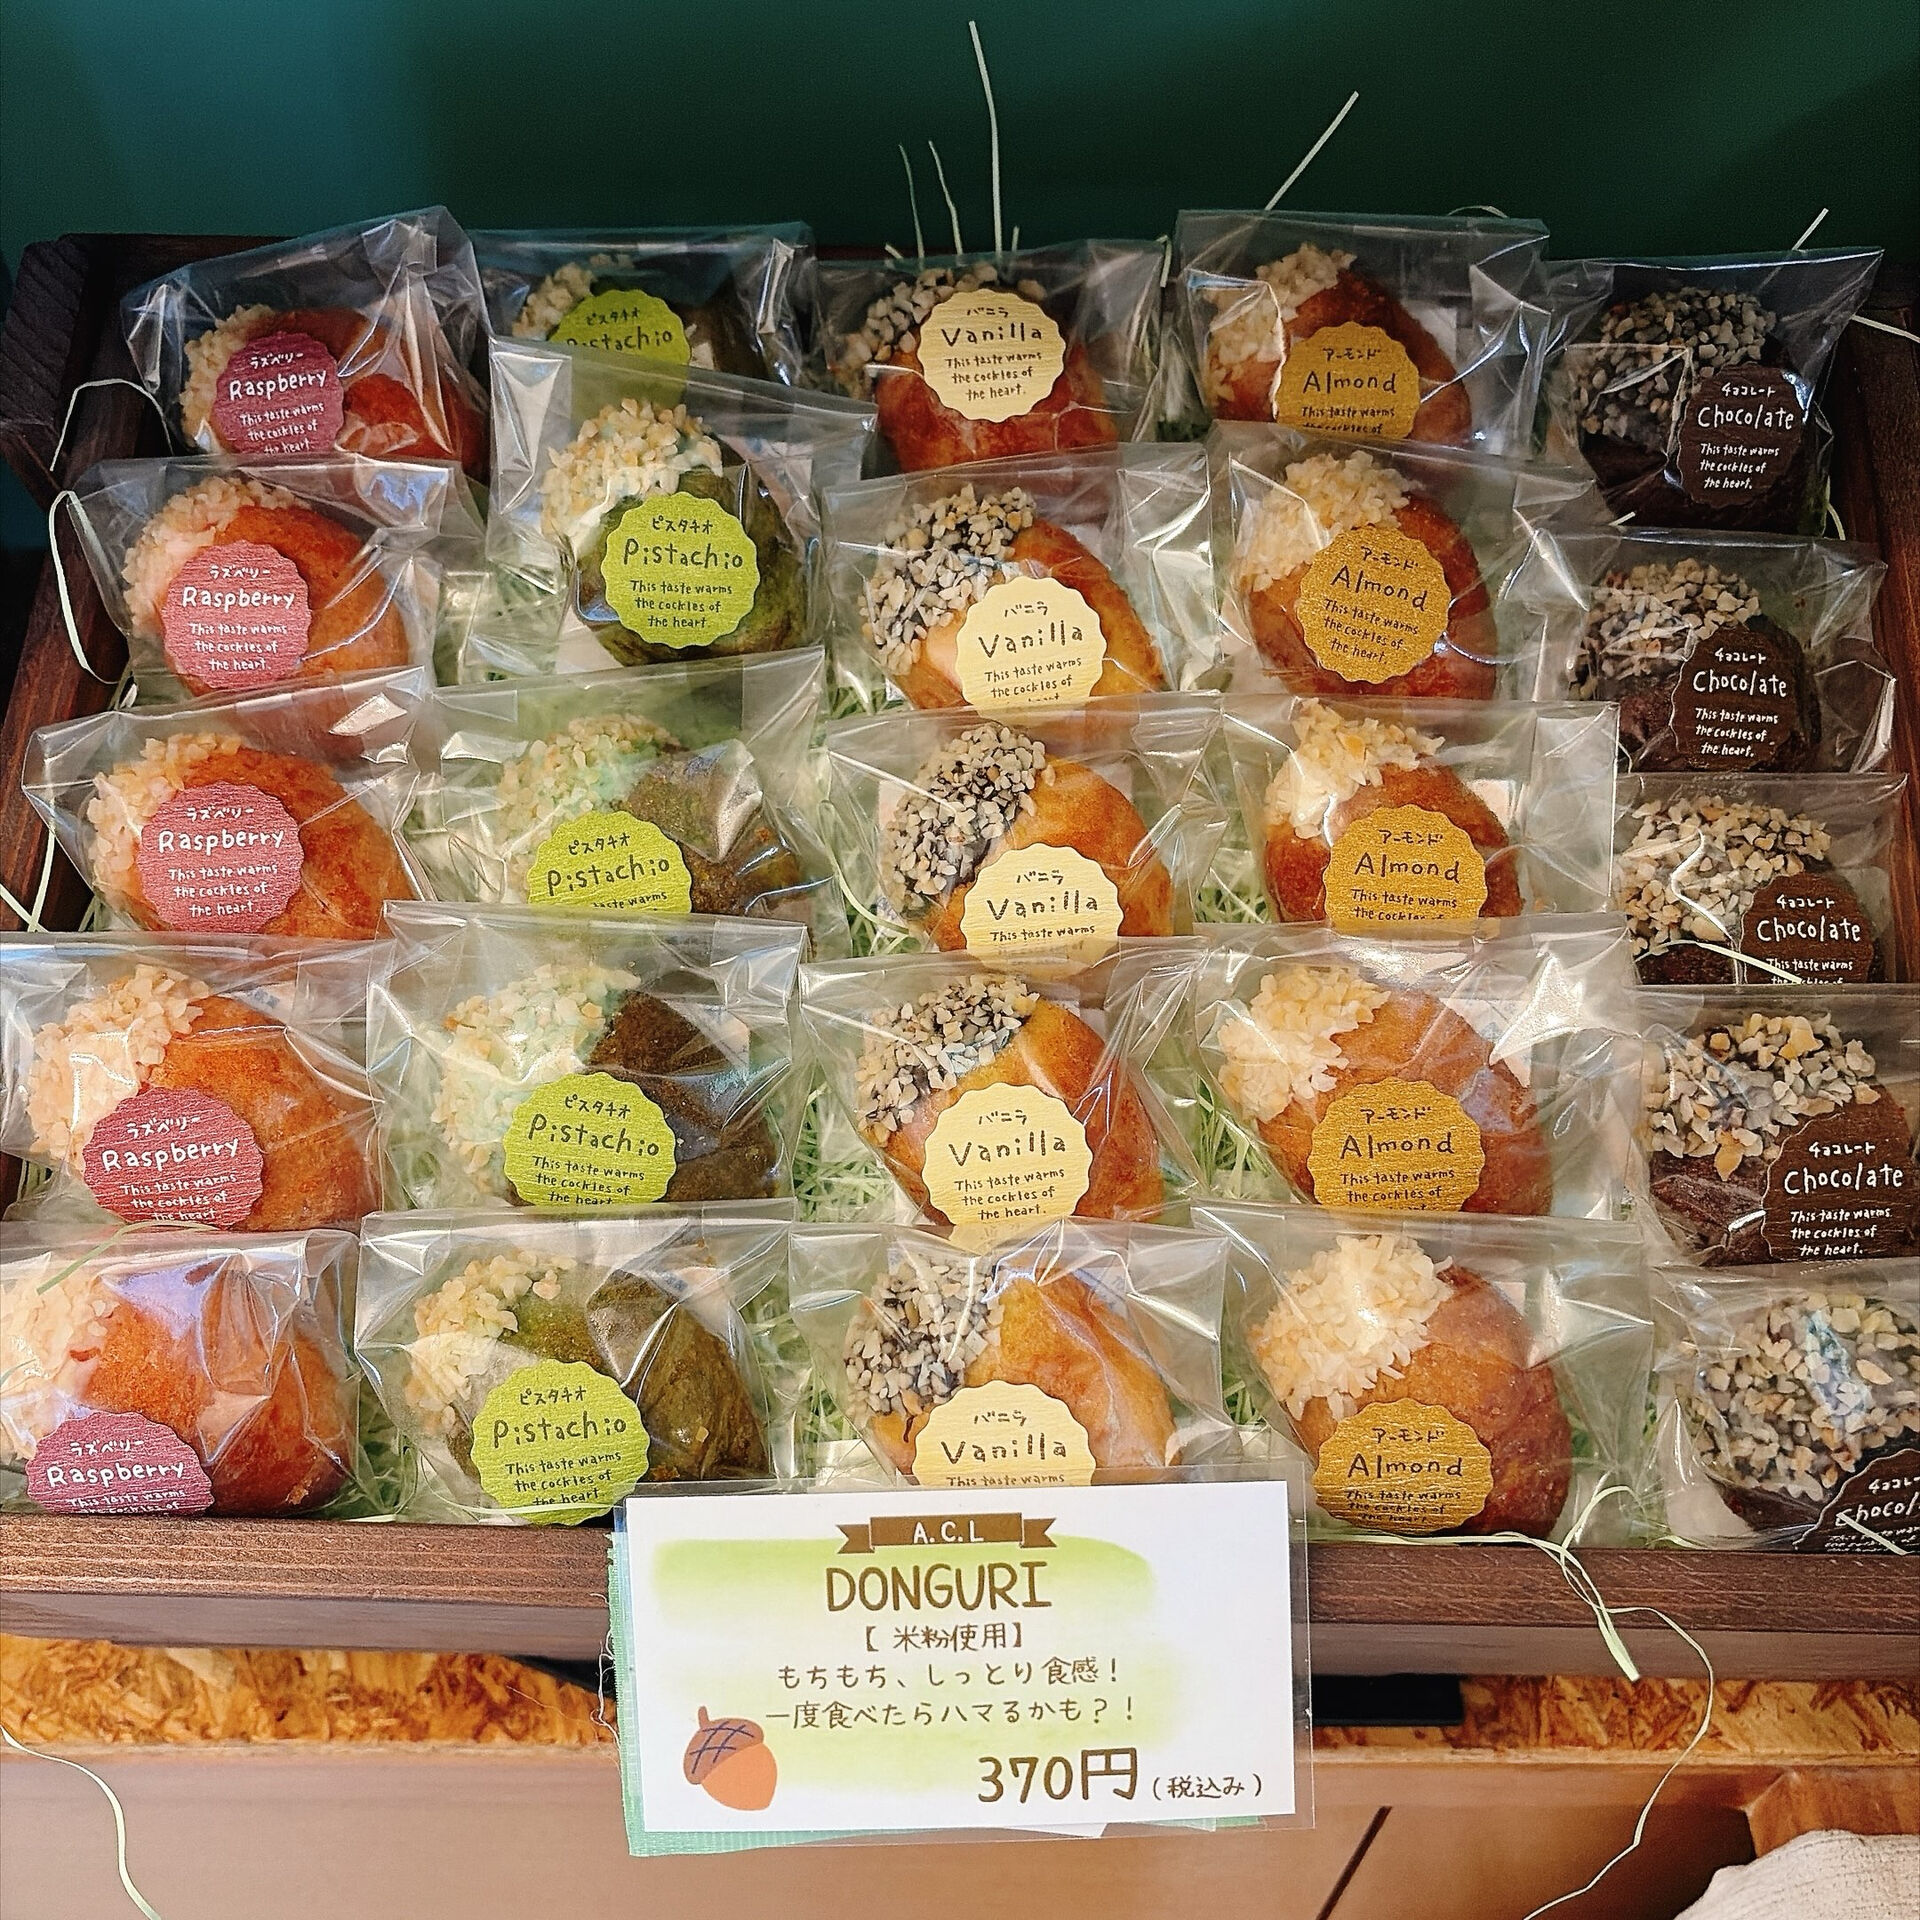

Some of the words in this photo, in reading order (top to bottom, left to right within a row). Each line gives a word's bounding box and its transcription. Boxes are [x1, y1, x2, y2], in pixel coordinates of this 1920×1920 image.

[941, 322, 1042, 347] Vanilla
[945, 358, 971, 369] This
[975, 355, 1002, 366] taste
[1007, 352, 1042, 361] warms
[230, 370, 326, 400] Raspberry
[952, 373, 971, 384] the
[974, 367, 1018, 381] cockles
[1021, 366, 1033, 377] of
[1302, 371, 1396, 394] Almond
[966, 389, 985, 401] the
[1698, 404, 1795, 430] Chocolate
[1700, 443, 1721, 456] This
[1723, 444, 1748, 457] taste
[1750, 447, 1780, 457] warms
[1700, 459, 1716, 471] the
[1717, 462, 1753, 473] cockles
[1755, 462, 1767, 474] of
[1704, 477, 1721, 489] the
[653, 515, 713, 534] ピスタチオ
[624, 538, 743, 569] Pistachio
[631, 580, 657, 592] This
[661, 581, 692, 594] taste
[695, 584, 732, 594] warms
[1330, 565, 1428, 612] Almond
[182, 586, 295, 613] Raspberry
[635, 597, 655, 609] the
[659, 601, 705, 612] cockles
[708, 601, 721, 613] of
[1004, 601, 1048, 618] バニラ
[1324, 598, 1348, 614] This
[1352, 607, 1380, 625] taste
[1383, 618, 1419, 635] warms
[189, 623, 214, 635] This
[218, 624, 248, 635] taste
[250, 625, 288, 634] warms
[978, 620, 1083, 658] Vanilla
[984, 670, 1010, 683] This
[1012, 664, 1043, 679] taste
[1046, 657, 1082, 671] warms
[990, 687, 1010, 699] the
[1013, 681, 1058, 696] cockles
[1061, 674, 1073, 687] of
[1693, 669, 1787, 697] Chocolate
[1695, 707, 1717, 720] This
[1720, 708, 1746, 722] taste
[1747, 714, 1779, 724] warms
[1695, 724, 1712, 736] the
[1713, 728, 1753, 741] cockles
[1755, 730, 1768, 742] of
[186, 806, 255, 821] ラズベリー
[159, 829, 284, 855] Raspberry
[569, 832, 630, 855] ピスタチオ
[1378, 830, 1443, 845] アーモンド
[168, 869, 195, 880] This
[200, 868, 233, 879] taste
[237, 865, 277, 876] warms
[547, 854, 670, 896] Pistachio
[1016, 870, 1064, 885] バニラ
[1354, 852, 1460, 884] Almond
[173, 886, 195, 897] the
[199, 885, 249, 897] cockles
[253, 881, 268, 894] of
[1351, 889, 1378, 901] This
[1382, 891, 1415, 905] taste
[1420, 897, 1457, 909] warms
[987, 890, 1098, 920] Vanilla
[990, 931, 1018, 941] This
[1020, 929, 1053, 940] taste
[1056, 926, 1095, 936] warms
[1757, 915, 1861, 942] Chocolate
[1792, 958, 1819, 971] taste
[1821, 960, 1853, 971] warms
[565, 1094, 631, 1118] ピスタチオ
[978, 1110, 1027, 1125] バニラ
[528, 1114, 659, 1156] Pistachio
[1340, 1131, 1455, 1160] Almond
[102, 1138, 238, 1171] Raspberry
[948, 1130, 1066, 1166] Vanilla
[533, 1156, 562, 1170] This
[566, 1161, 600, 1176] taste
[604, 1169, 645, 1181] warms
[1340, 1173, 1370, 1185] This
[1374, 1172, 1409, 1184] taste
[1412, 1170, 1455, 1181] warms
[1784, 1162, 1904, 1194] Chocolate
[536, 1173, 558, 1187] the
[561, 1179, 612, 1194] cockles
[616, 1185, 631, 1196] of
[954, 1179, 983, 1192] This
[987, 1174, 1020, 1188] taste
[1024, 1169, 1065, 1182] warms
[962, 1196, 984, 1206] the
[987, 1190, 1037, 1204] cockles
[1042, 1186, 1055, 1198] of
[1348, 1190, 1369, 1203] the
[1373, 1189, 1424, 1201] cockles
[1430, 1185, 1443, 1197] of
[978, 1209, 1000, 1220] the
[1790, 1211, 1817, 1223] This
[1820, 1209, 1850, 1222] taste
[1853, 1208, 1891, 1218] warms
[1791, 1228, 1811, 1240] the
[1813, 1227, 1861, 1239] cockles
[1864, 1224, 1878, 1237] of
[1801, 1244, 1820, 1256] the
[520, 1385, 586, 1405] ピスタチオ
[494, 1410, 627, 1448] Pistachio
[974, 1410, 1027, 1426] バニラ
[940, 1432, 1066, 1464] Vanilla
[47, 1461, 184, 1488] Raspberry
[505, 1462, 535, 1475] This
[539, 1458, 574, 1472] taste
[578, 1451, 622, 1466] warms
[1347, 1453, 1462, 1478] Almond
[514, 1480, 536, 1493] the
[541, 1475, 594, 1490] cockles
[598, 1469, 611, 1480] of
[946, 1476, 977, 1487] This
[982, 1475, 1018, 1486] taste
[1021, 1473, 1064, 1484] warms
[913, 1520, 984, 1544] A.C.L
[826, 1561, 1052, 1612] DONGURI
[977, 1747, 1138, 1804] 370円
